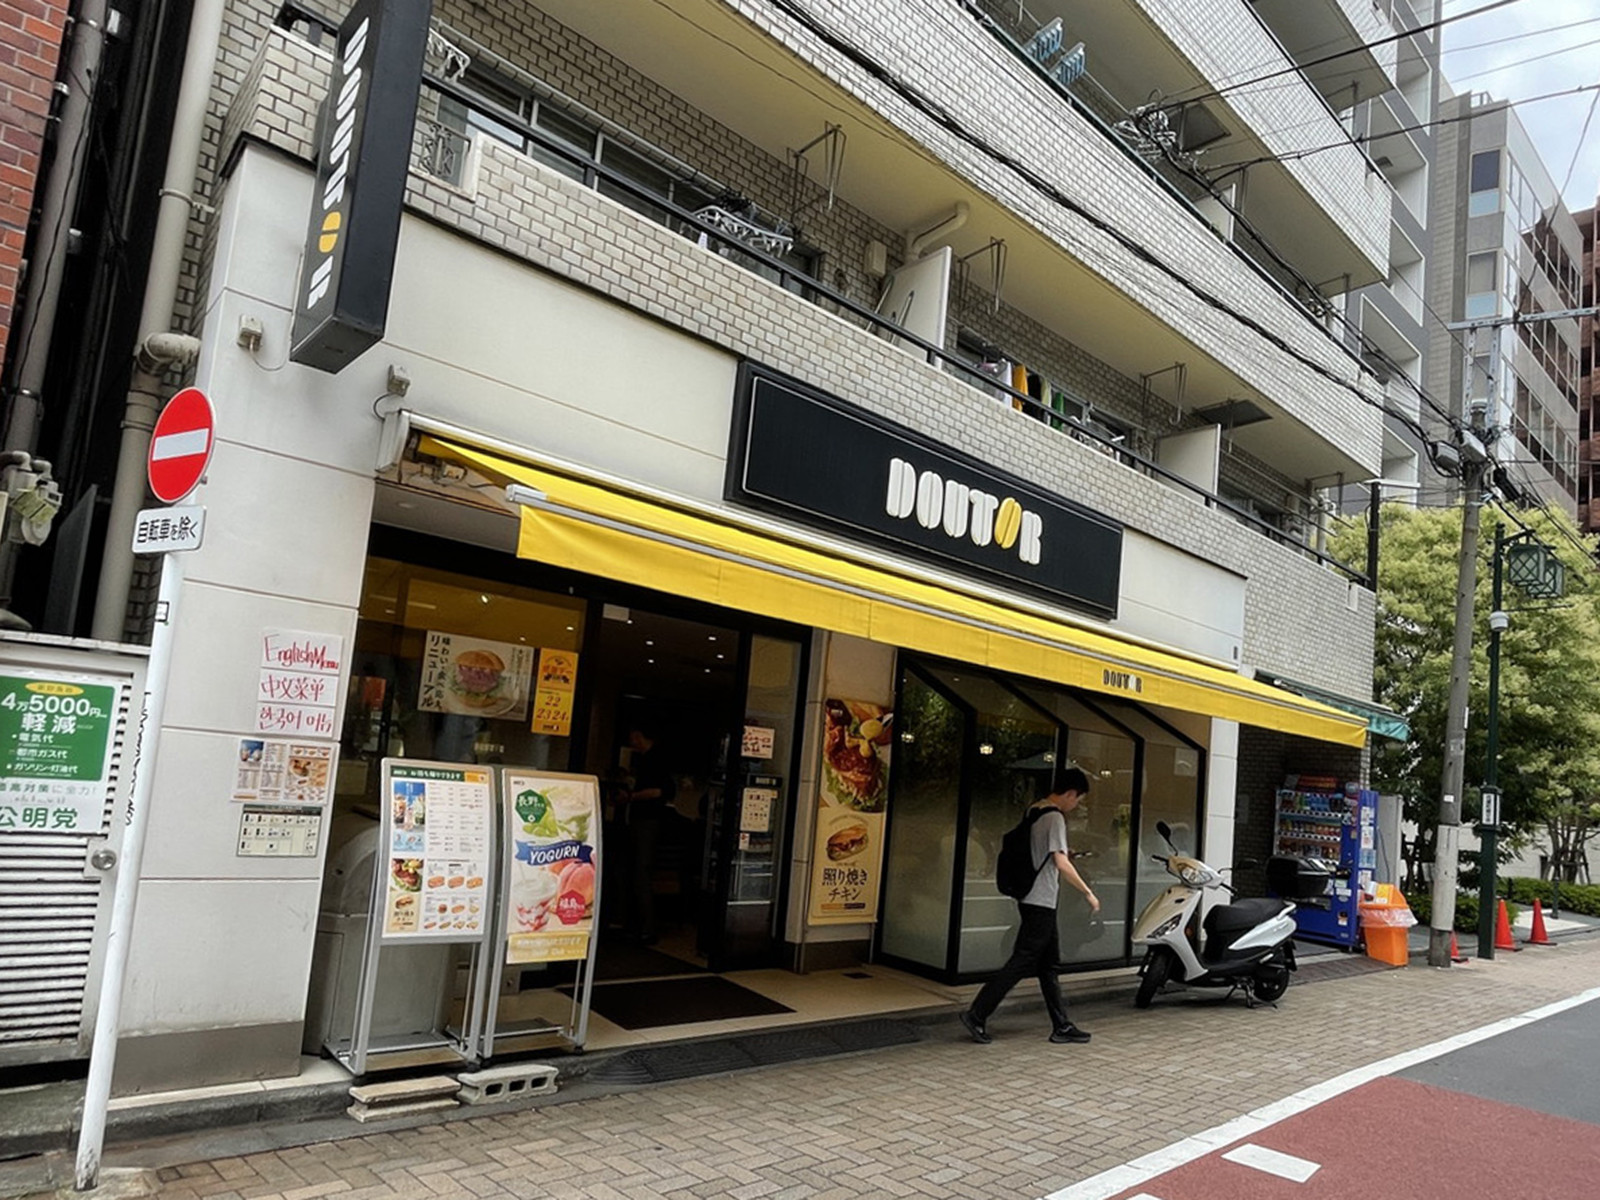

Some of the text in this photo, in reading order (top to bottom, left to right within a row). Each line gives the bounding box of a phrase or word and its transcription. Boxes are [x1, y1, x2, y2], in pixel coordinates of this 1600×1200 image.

[307, 17, 369, 309] DOUTOR
[886, 457, 1043, 566] DOUTOR
[136, 516, 198, 543] 自転車を除く
[421, 635, 441, 708] リニューアル
[261, 675, 325, 701] 中文菜单
[21, 712, 77, 735] 軽減
[530, 845, 580, 864] YOGURN
[822, 867, 868, 886] 照り焼き
[828, 886, 861, 903] チキン
